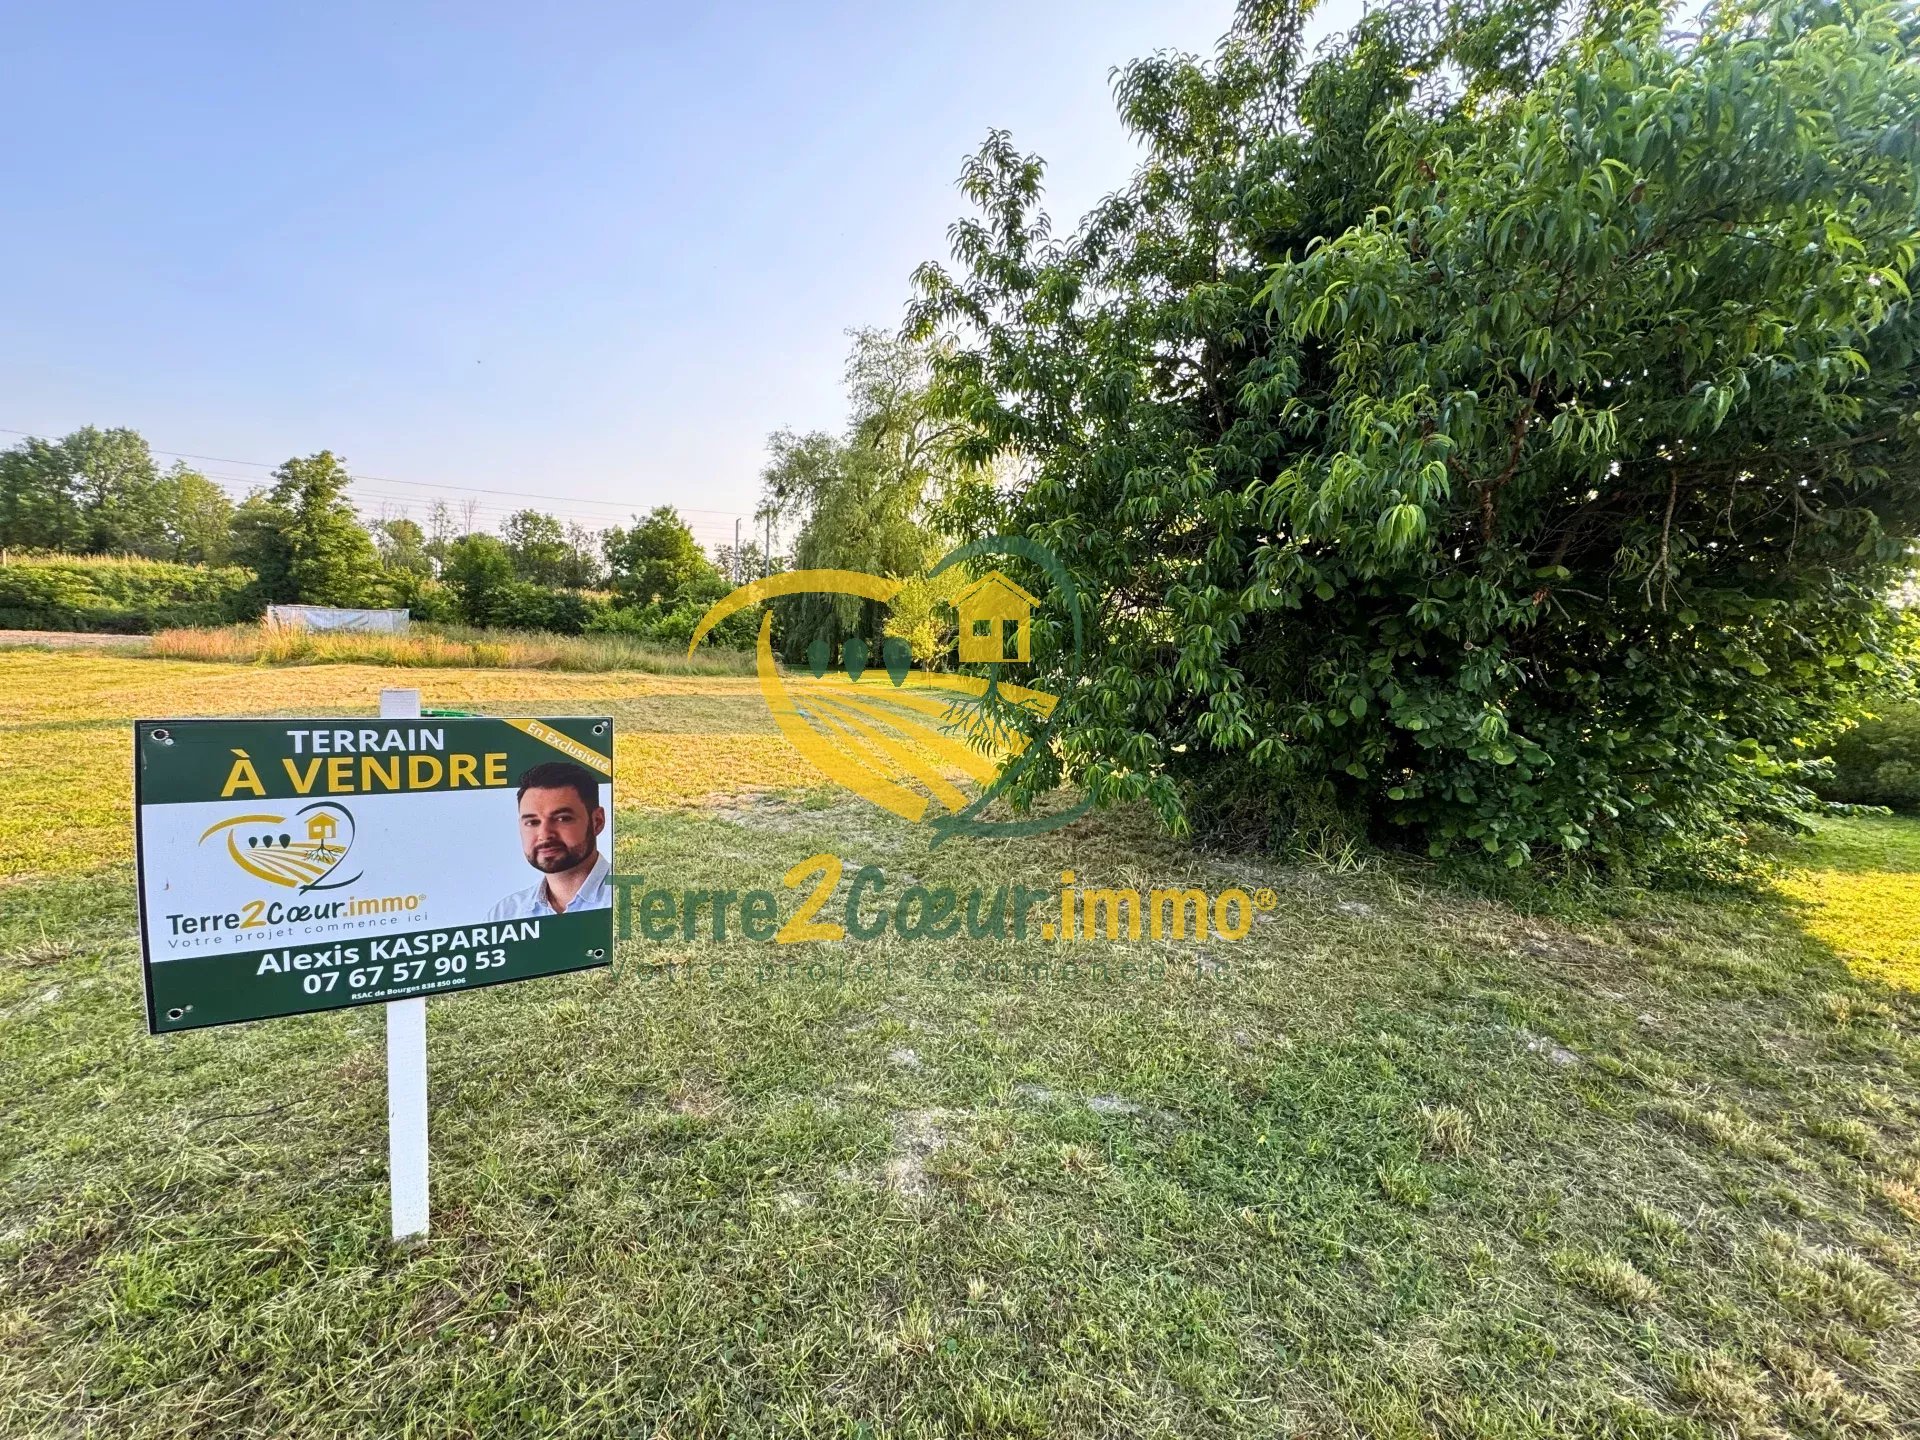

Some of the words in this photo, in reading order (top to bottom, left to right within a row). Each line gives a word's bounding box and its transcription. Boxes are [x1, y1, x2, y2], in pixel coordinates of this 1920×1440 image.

[286, 728, 444, 754] TERRAIN
[526, 722, 544, 738] En
[545, 731, 609, 772] Exclusivité
[221, 748, 267, 797] À
[282, 752, 508, 795] VENDRE
[168, 935, 222, 949] Votre
[235, 927, 294, 944] projet
[304, 915, 398, 934] commence
[408, 911, 428, 923] ici
[256, 945, 360, 976] Alexis
[370, 920, 540, 962] KASPARIAN
[303, 971, 340, 994] 07
[349, 965, 385, 988] 67
[392, 959, 427, 983] 57
[435, 954, 467, 977] 90
[475, 949, 506, 970] 53
[351, 991, 373, 1000] RSAC
[375, 988, 385, 997] de
[387, 985, 420, 995] Bourges
[437, 980, 451, 988] 850
[452, 977, 466, 985] 006
